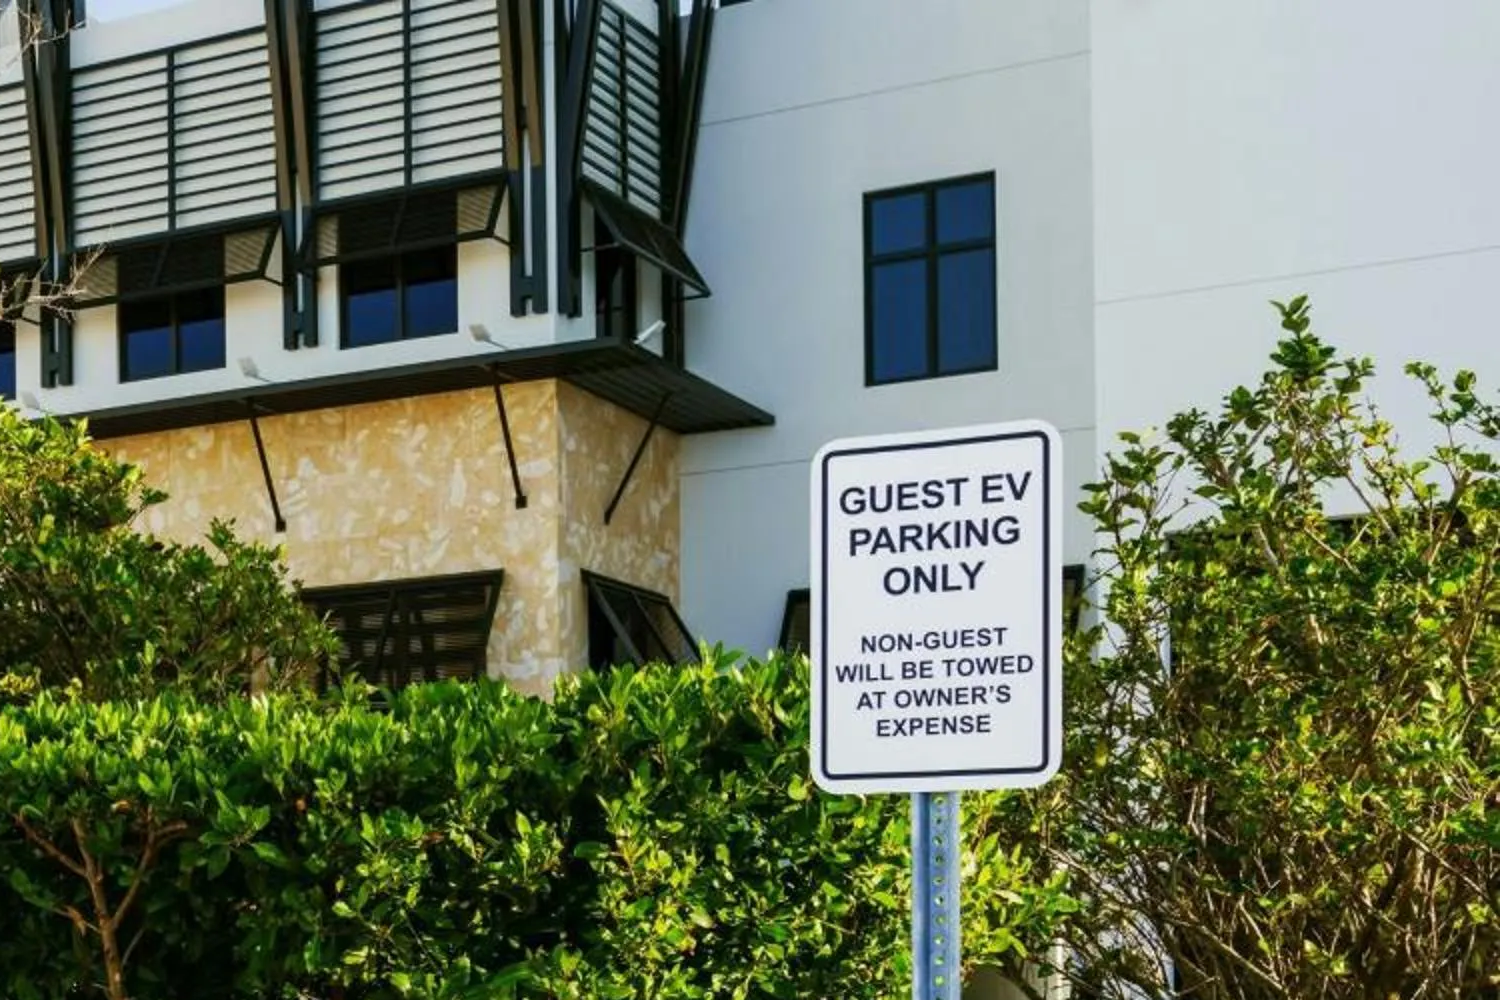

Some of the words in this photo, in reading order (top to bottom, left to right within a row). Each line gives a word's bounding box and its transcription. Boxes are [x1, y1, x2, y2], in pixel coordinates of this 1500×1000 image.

[839, 473, 970, 516] GUEST
[980, 471, 1032, 504] EV
[849, 516, 1020, 557] PARKING
[883, 561, 985, 596] ONLY
[860, 627, 1008, 654] NON-GUEST
[835, 663, 894, 683] WILL
[901, 660, 933, 680] BE
[941, 655, 1034, 677] TOWED
[856, 691, 887, 711] AT
[876, 714, 991, 738] EXPENSE
